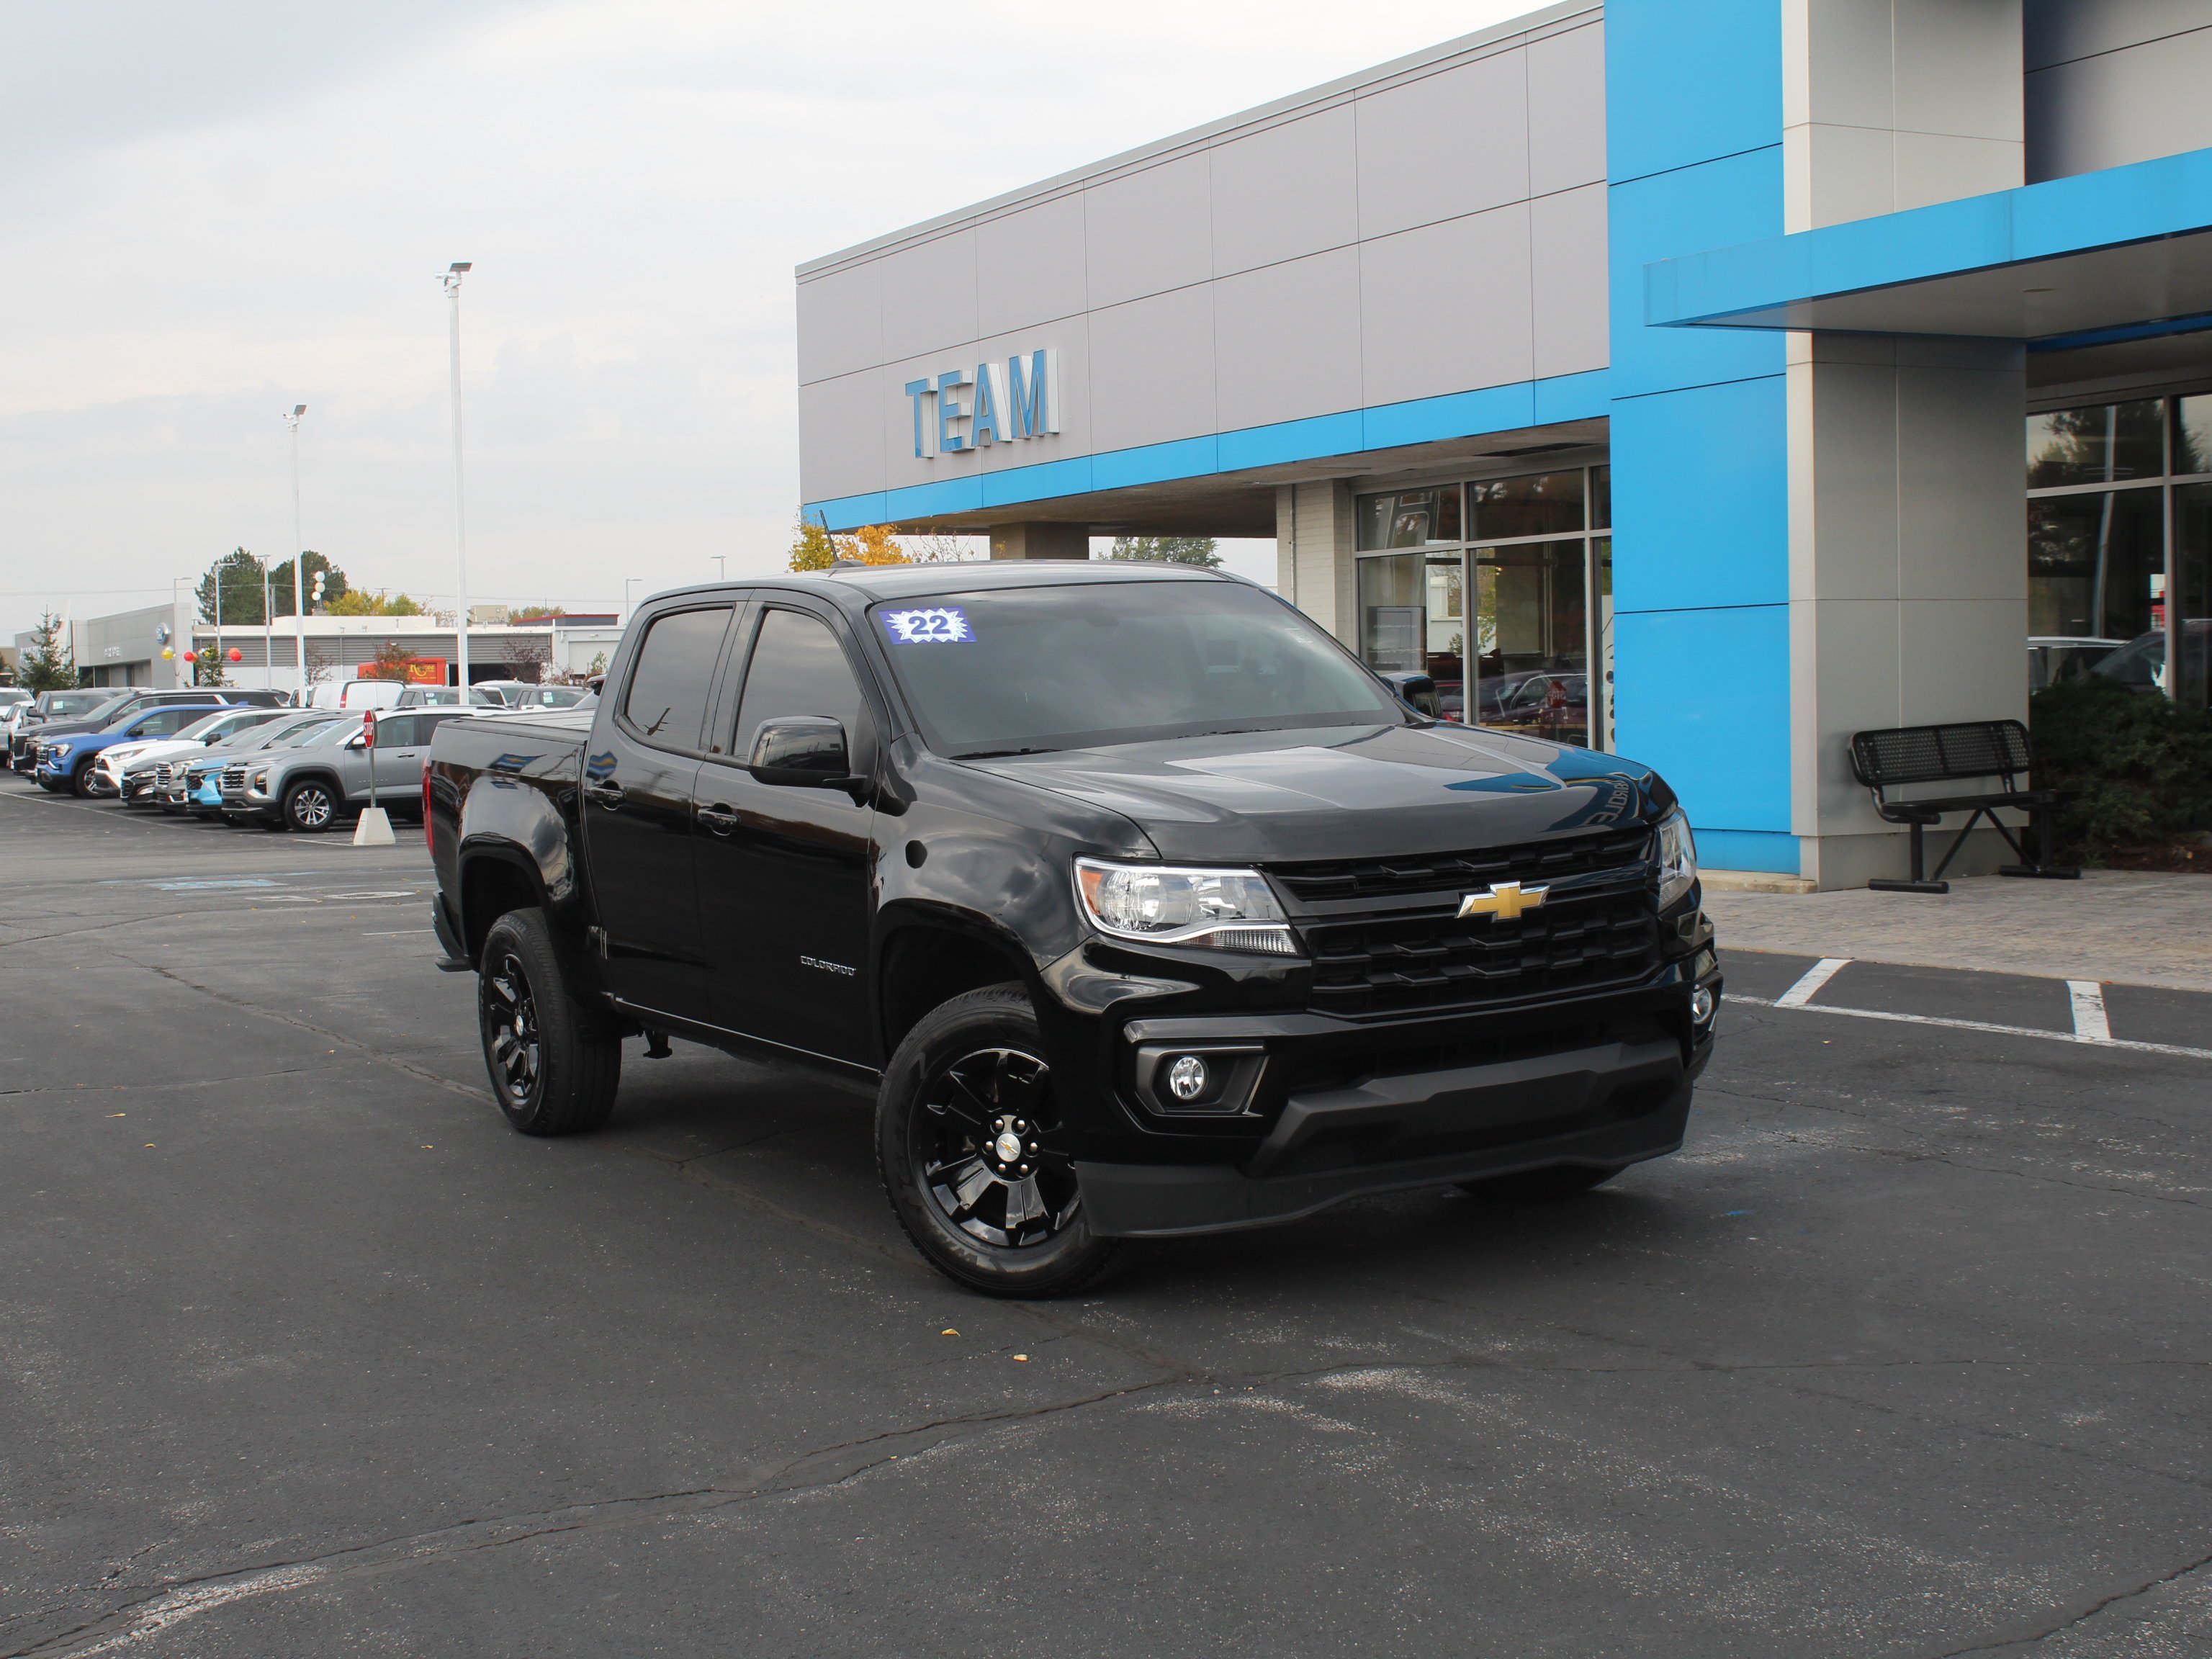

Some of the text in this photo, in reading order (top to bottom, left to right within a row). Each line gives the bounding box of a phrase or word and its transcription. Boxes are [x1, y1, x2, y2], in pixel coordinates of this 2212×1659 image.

[905, 349, 1059, 458] TEAM
[908, 616, 952, 635] 22
[364, 721, 374, 736] STOP
[801, 956, 855, 976] COLORADO
